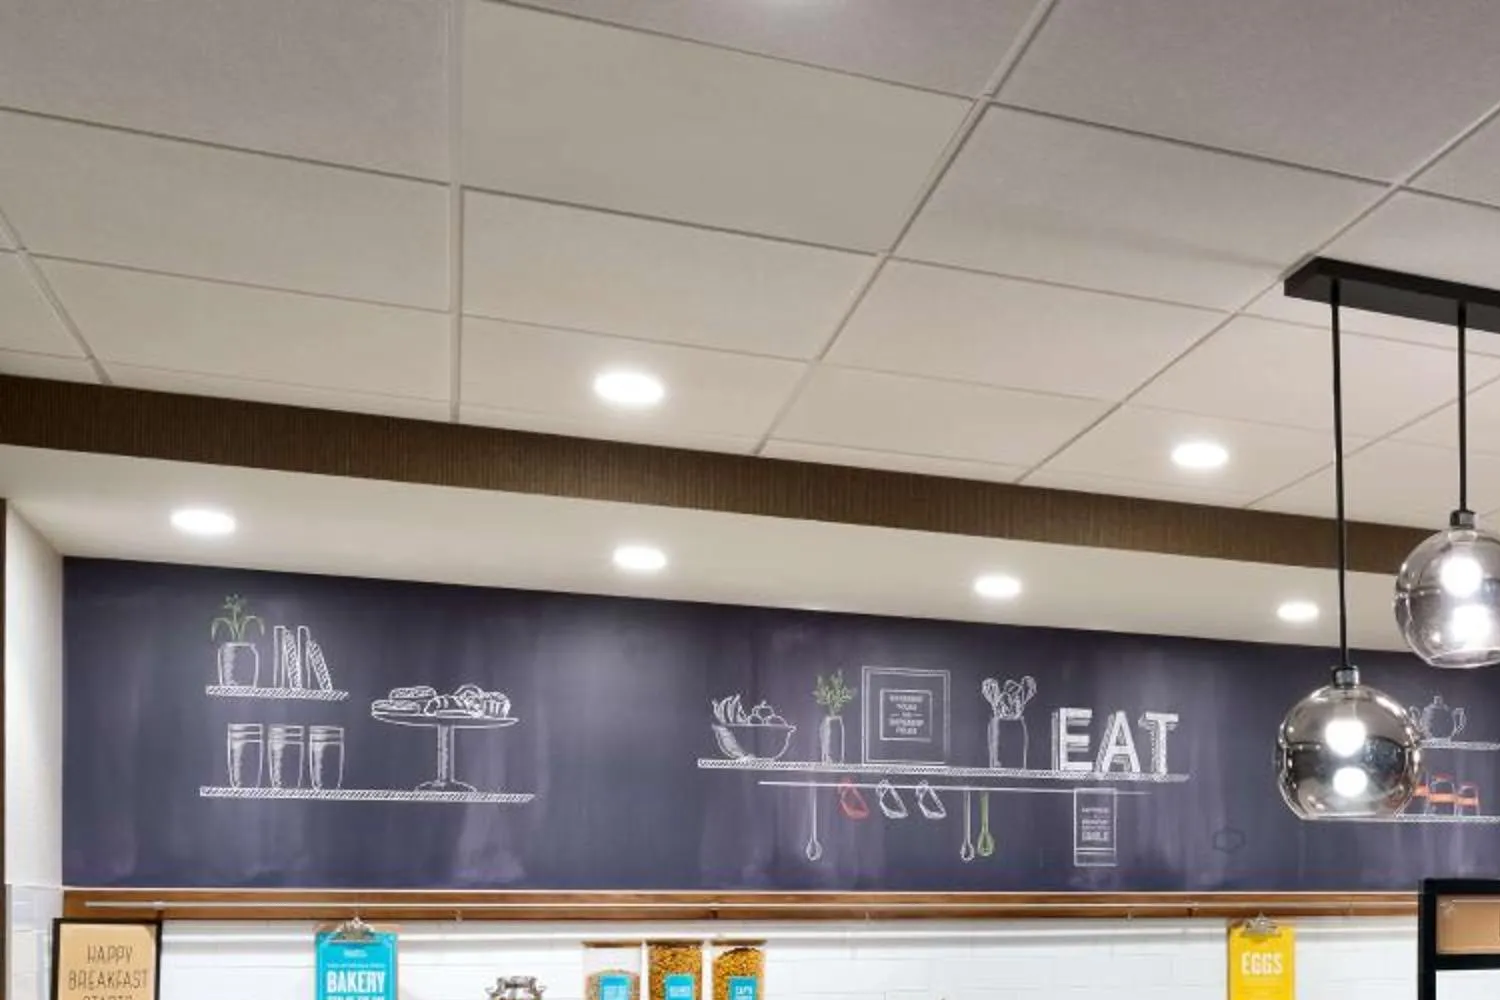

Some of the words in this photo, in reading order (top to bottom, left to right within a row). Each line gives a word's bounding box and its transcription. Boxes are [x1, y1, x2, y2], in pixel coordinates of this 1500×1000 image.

[1051, 706, 1180, 777] EAT
[87, 945, 133, 964] HAPPY
[1241, 951, 1284, 976] EGGS
[68, 968, 147, 990] BREAKFAST
[326, 971, 386, 993] BAKERY
